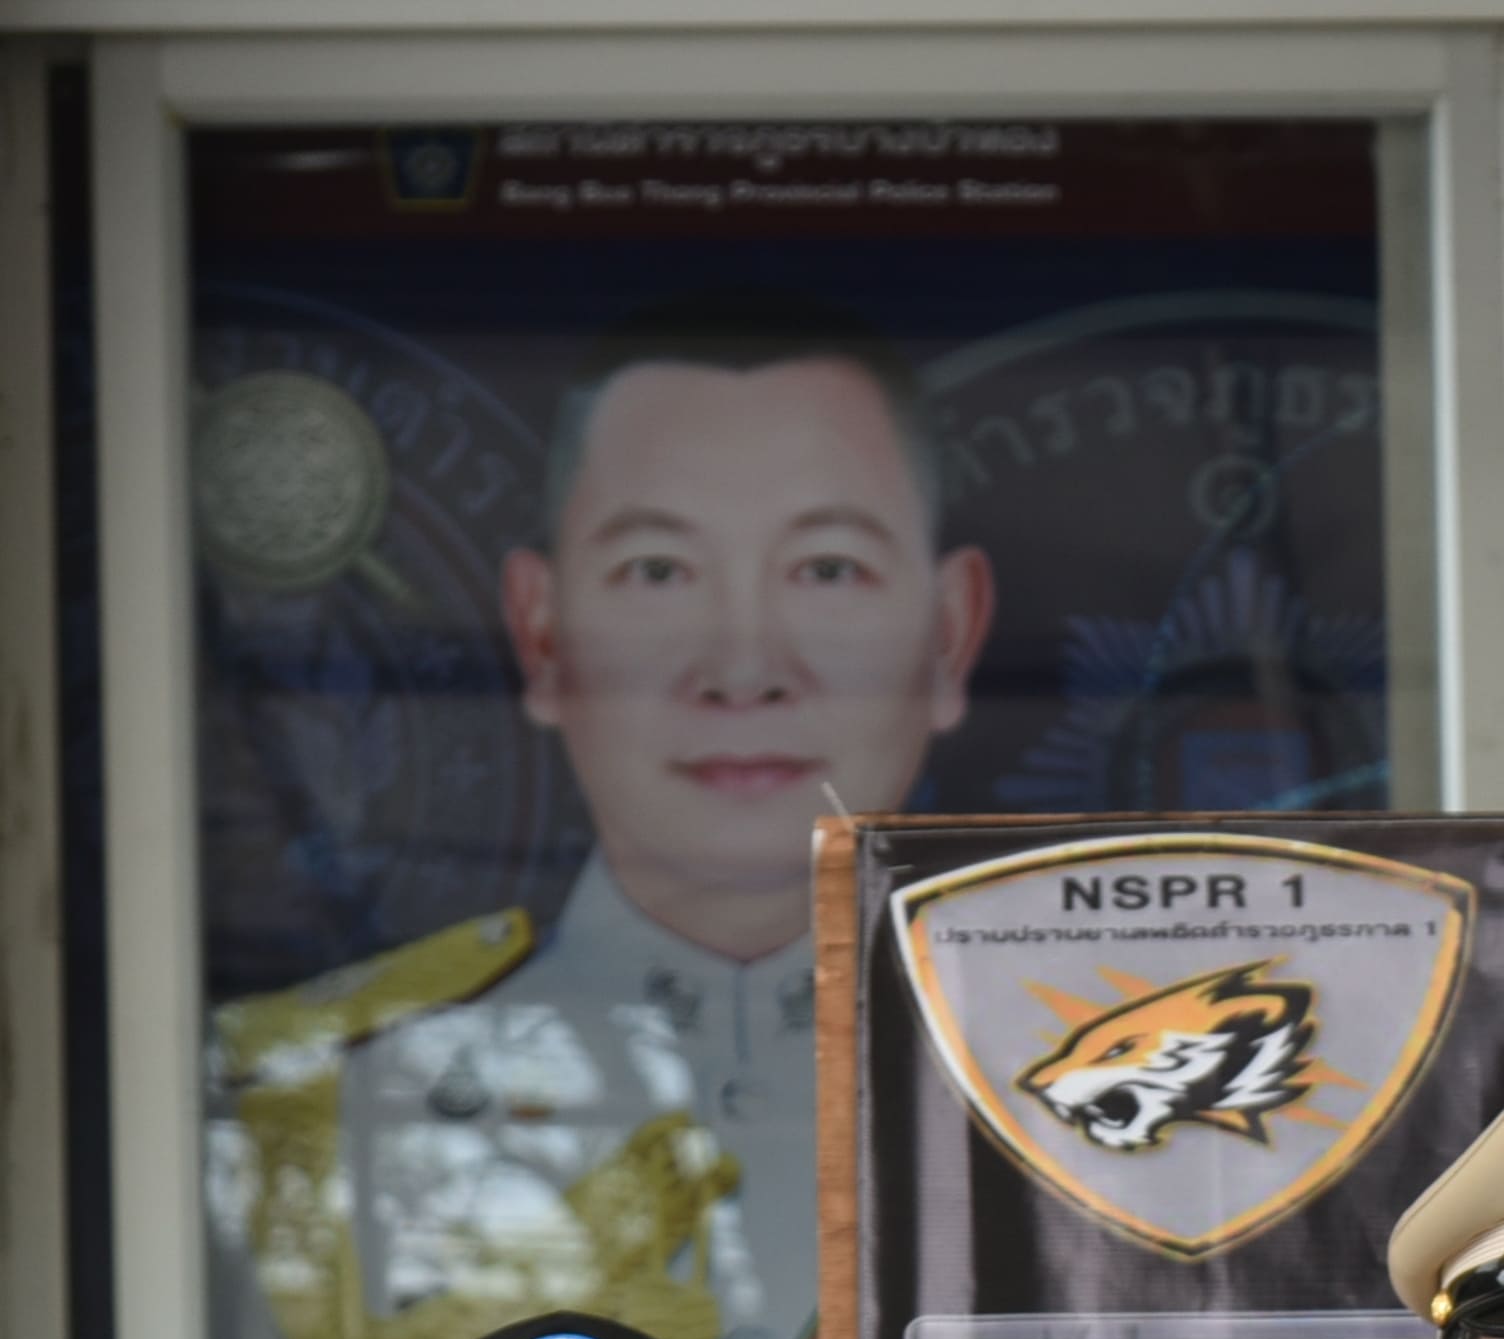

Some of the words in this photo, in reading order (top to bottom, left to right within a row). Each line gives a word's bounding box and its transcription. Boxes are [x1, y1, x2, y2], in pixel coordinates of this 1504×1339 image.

[868, 178, 949, 204] Police
[956, 178, 1060, 203] Station
[1060, 875, 1249, 911] NSPR
[1281, 874, 1308, 908] 1
[1426, 920, 1438, 938] 1
